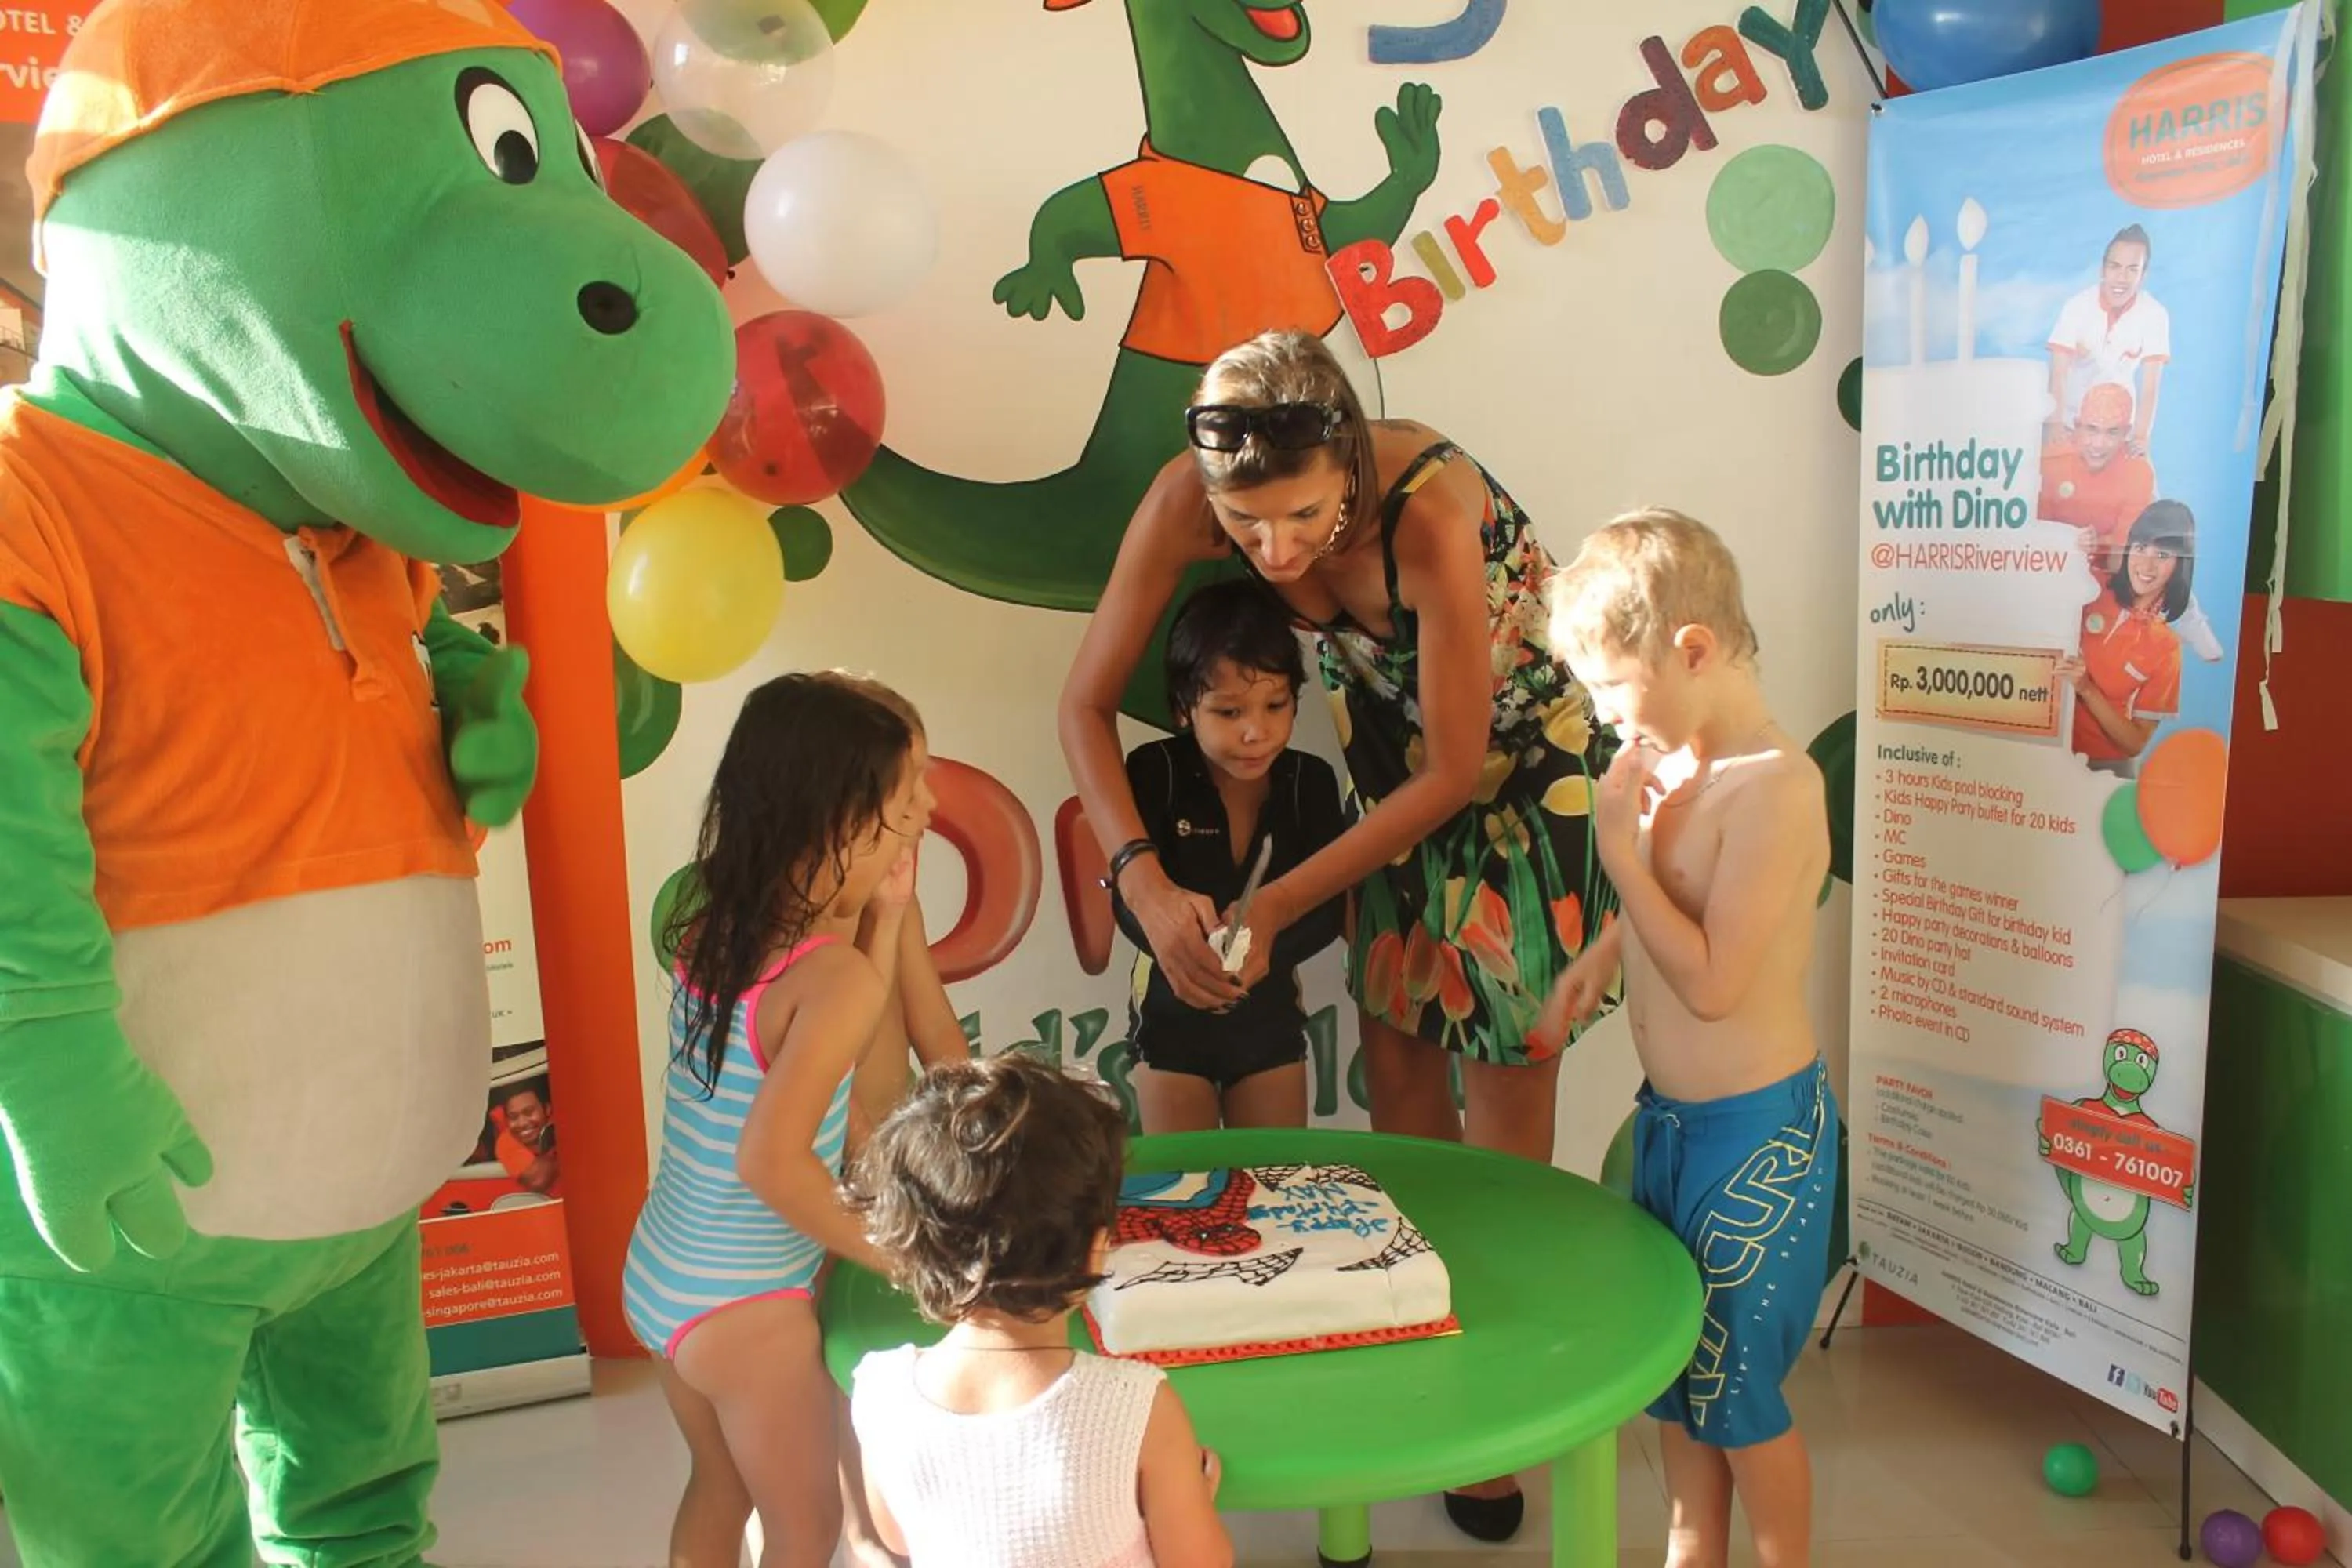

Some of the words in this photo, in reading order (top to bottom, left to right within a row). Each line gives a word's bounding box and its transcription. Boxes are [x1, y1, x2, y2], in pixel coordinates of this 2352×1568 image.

[2129, 91, 2268, 150] HARRIS
[1876, 437, 2024, 491] Birthday
[1873, 489, 1944, 529] with
[1952, 488, 2027, 529] Dino
[1871, 543, 2068, 574] @HARRISRiverview
[1890, 673, 1913, 691] Rp.
[1915, 666, 2014, 700] 3,000,000
[2019, 685, 2049, 702] nett
[1878, 745, 1938, 764] Inclusive
[1886, 769, 1893, 783] 3
[1898, 768, 1929, 788] hours
[1932, 775, 1953, 792] Kids
[1955, 779, 1976, 796] pool
[1978, 782, 2024, 808] blocking
[1884, 789, 1911, 805] Kids
[1915, 793, 1948, 815] Happy
[1951, 797, 1975, 821] Party
[1978, 803, 2008, 822] buffet
[2011, 808, 2026, 826] for
[2030, 812, 2045, 829] 20
[2049, 815, 2077, 833] kids
[1884, 808, 1912, 826] Dino
[1883, 829, 1907, 844] MC
[1883, 848, 1926, 869] Games
[1883, 869, 1911, 886] Gifts
[1914, 872, 1927, 887] for
[1931, 876, 1946, 893] the
[1949, 884, 1982, 902] games
[1985, 892, 2019, 911] winner
[1882, 888, 1925, 908] Special
[1926, 895, 1967, 921] Birthday
[1969, 906, 1984, 924] Gift
[1987, 909, 2001, 927] for
[2003, 913, 2049, 944] birthday
[2053, 925, 2071, 945] kid
[1882, 908, 1922, 930] Happy
[1925, 918, 1950, 938] party
[1952, 922, 2008, 952] decorations
[2011, 938, 2020, 954] &
[2022, 940, 2074, 967] balloons
[1882, 927, 1898, 942] 20
[1901, 930, 1925, 948] Dino
[1927, 939, 1953, 958] party
[1955, 943, 1971, 963] hat
[1881, 946, 1931, 969] Invitation
[1933, 961, 1955, 977] card
[1881, 966, 1915, 985] Music
[1918, 972, 1929, 993] by
[1932, 978, 1947, 994] CD
[1948, 982, 1957, 997] &
[1958, 988, 2005, 1014] standard
[2005, 1004, 2039, 1025] sound
[2041, 1014, 2085, 1037] system
[1881, 985, 1889, 1000] 2
[1892, 989, 1957, 1018] microphones
[1879, 1004, 1912, 1025] Photo
[1915, 1016, 1943, 1033] event
[1955, 1026, 1971, 1042] CD
[2053, 1133, 2092, 1161] 0361
[2114, 1152, 2183, 1189] 761007
[422, 1252, 561, 1281] es-jakarta@tauzia.com
[1872, 1252, 1918, 1287] TAUZIA
[425, 1288, 564, 1318] singapore@tauzia.com
